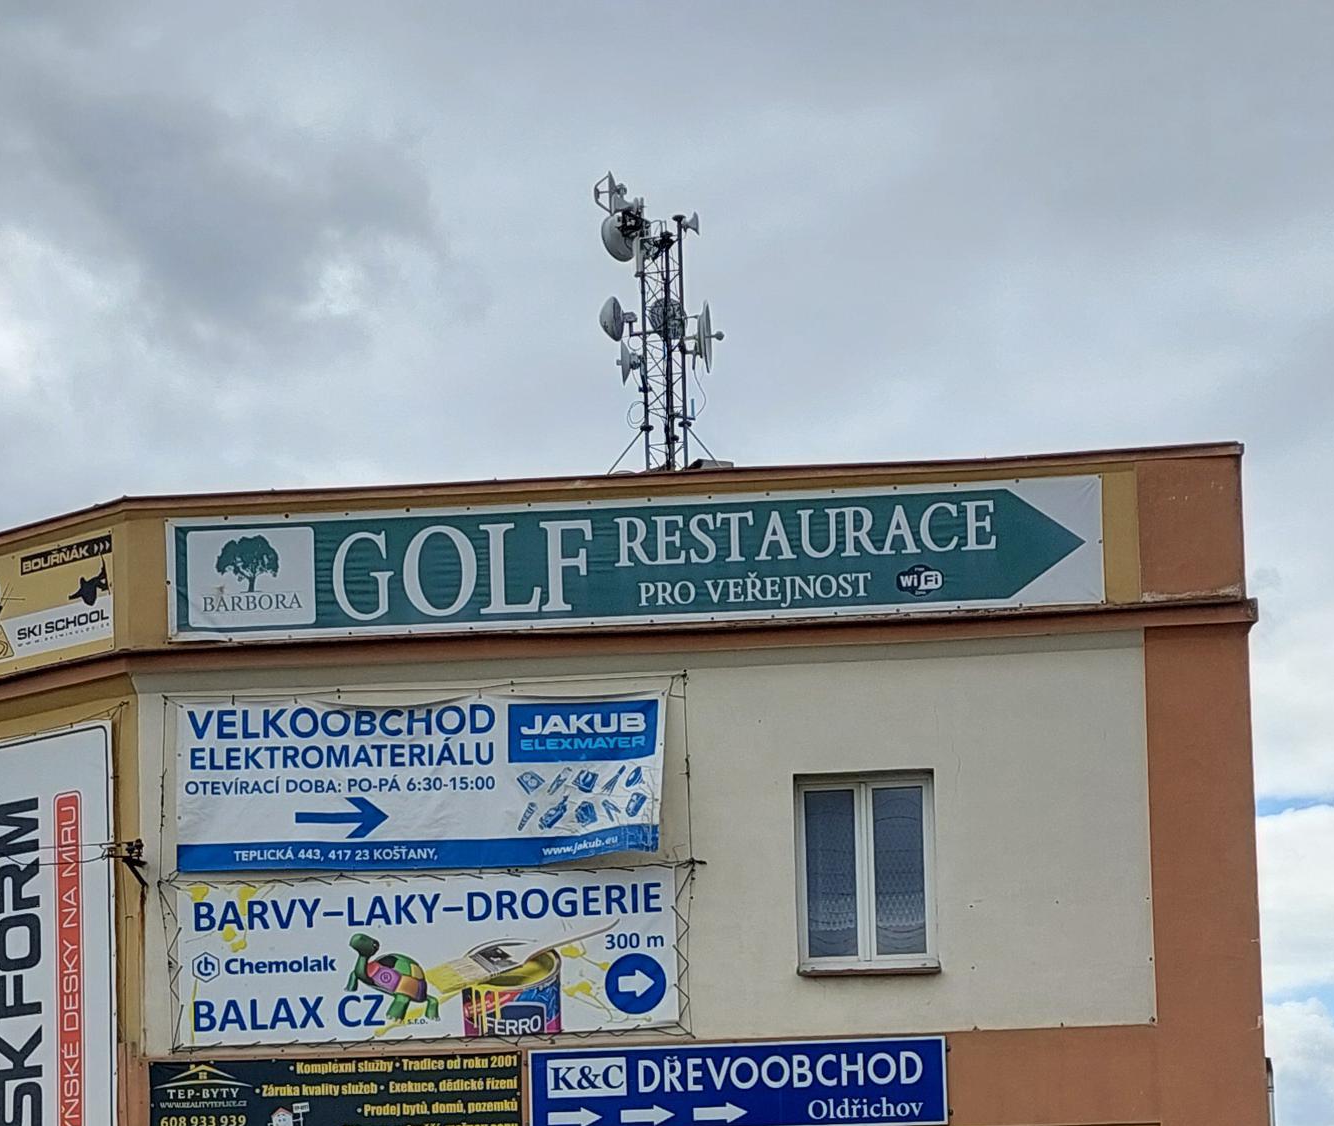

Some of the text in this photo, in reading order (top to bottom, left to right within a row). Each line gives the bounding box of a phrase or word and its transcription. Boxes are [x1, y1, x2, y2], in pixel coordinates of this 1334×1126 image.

[22, 545, 89, 573] BOURŇÁK
[332, 499, 997, 622] GOLF RESTAURACE
[638, 580, 696, 607] PRO
[704, 572, 871, 607] VEŘEJNOST
[202, 591, 303, 613] BARBORA
[17, 624, 42, 641] SKI
[44, 609, 110, 634] SCHOOL
[187, 704, 496, 740] VELKOOBCHOD
[520, 712, 647, 736] JAKUB
[190, 738, 495, 770] ELEKTROMATERIÁLU
[520, 735, 647, 751] ELEXMAYER
[185, 773, 496, 796] OTEVÍRACÍ DOBA: PO-PÁ 6:30-15:00
[59, 806, 76, 878] MÍRU
[542, 835, 619, 855] www.jakub.eu
[233, 845, 438, 864] TEPLICKÁ 443, 417 23 KOŠŤANY,
[62, 886, 78, 929] NA
[604, 933, 665, 950] 300 m
[224, 955, 337, 976] Chemolak
[63, 939, 79, 1032] DESKY
[194, 996, 324, 1033] BALAX
[338, 994, 386, 1027] CZ
[484, 1015, 541, 1035] FERRO
[296, 1055, 517, 1075] Komplexní služby Tradice od roku 2001
[550, 1051, 924, 1094] K&C DŘEVOOBCHOD
[167, 1088, 240, 1099] TEP-BYTY
[262, 1076, 518, 1097] Záruka kvality služeb Exekuce, dědické řízení
[363, 1103, 401, 1117] Prodej
[468, 1097, 518, 1114] pozemků
[807, 1097, 924, 1121] Oldřichov
